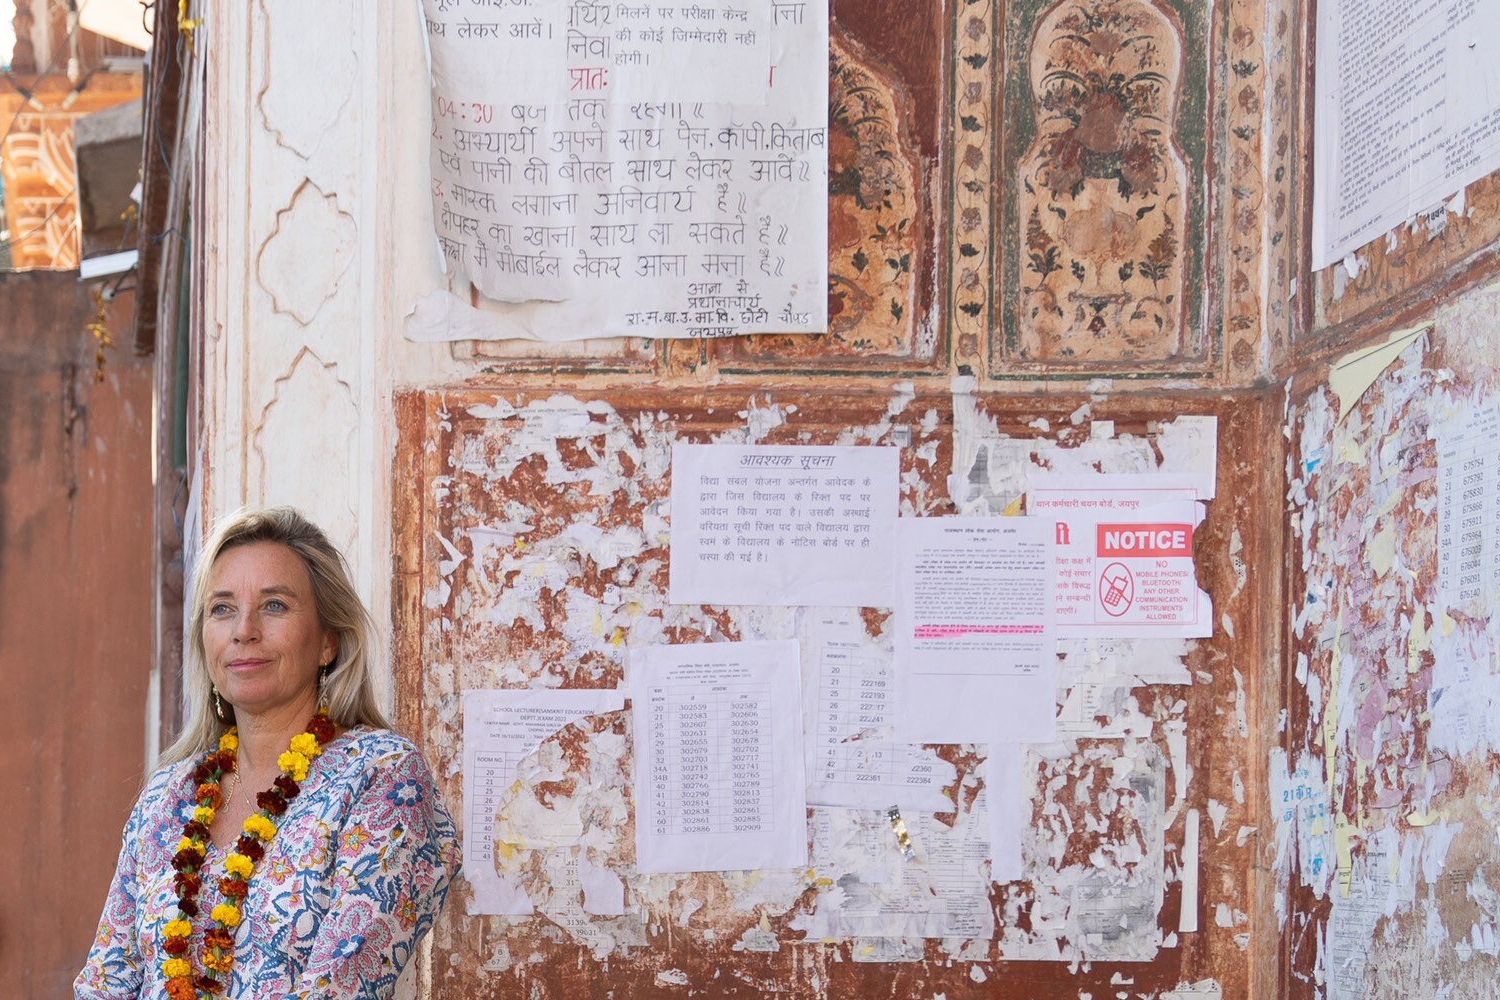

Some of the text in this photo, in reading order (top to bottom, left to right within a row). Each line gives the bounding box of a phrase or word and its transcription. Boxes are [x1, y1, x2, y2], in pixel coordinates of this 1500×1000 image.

[658, 8, 673, 19] पर
[615, 28, 631, 43] की
[639, 27, 664, 43] कोई
[618, 127, 665, 151] साथ
[523, 156, 550, 186] की
[627, 159, 676, 183] साथ
[590, 222, 638, 247] साथ
[739, 454, 836, 470] आवश्यक सूचना
[1105, 530, 1186, 550] NOTICE
